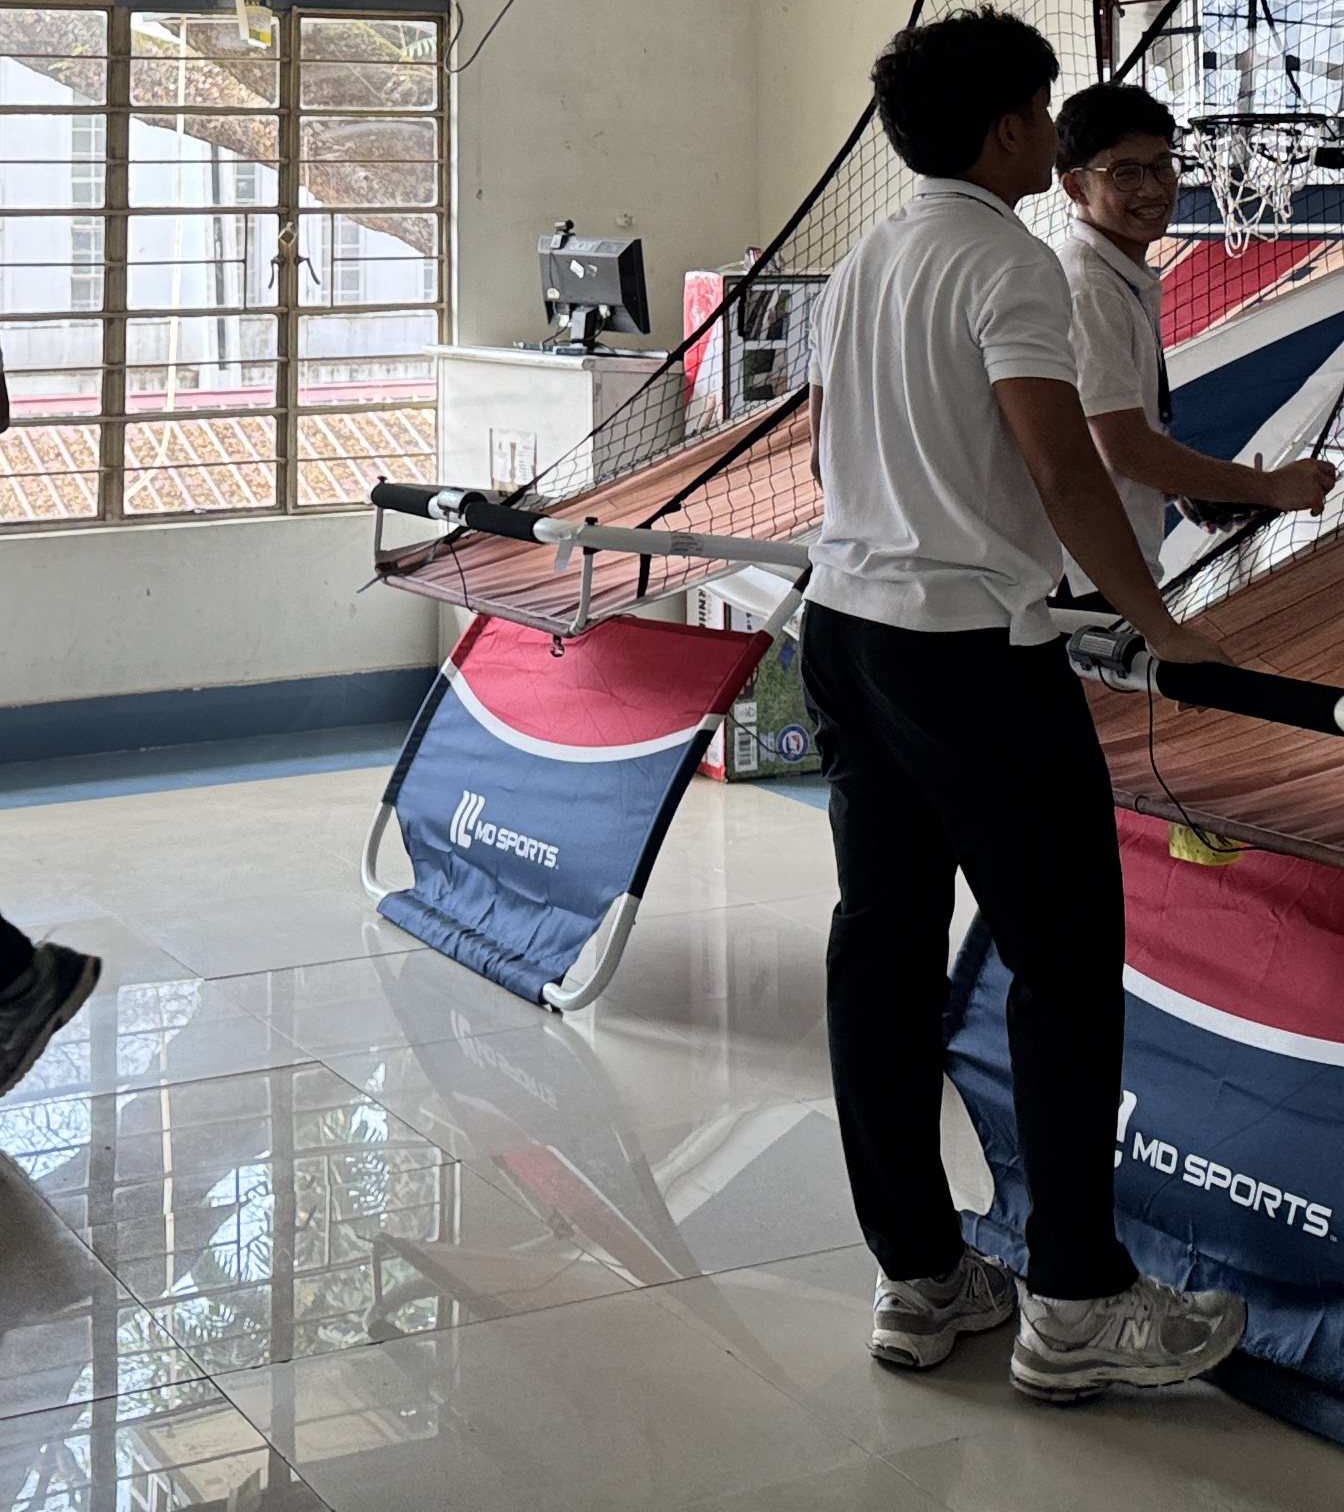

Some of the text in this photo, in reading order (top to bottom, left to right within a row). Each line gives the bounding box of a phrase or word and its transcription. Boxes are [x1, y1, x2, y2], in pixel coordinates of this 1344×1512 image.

[474, 820, 560, 869] MD SPORTS
[1132, 1131, 1333, 1238] MD SPORTS
